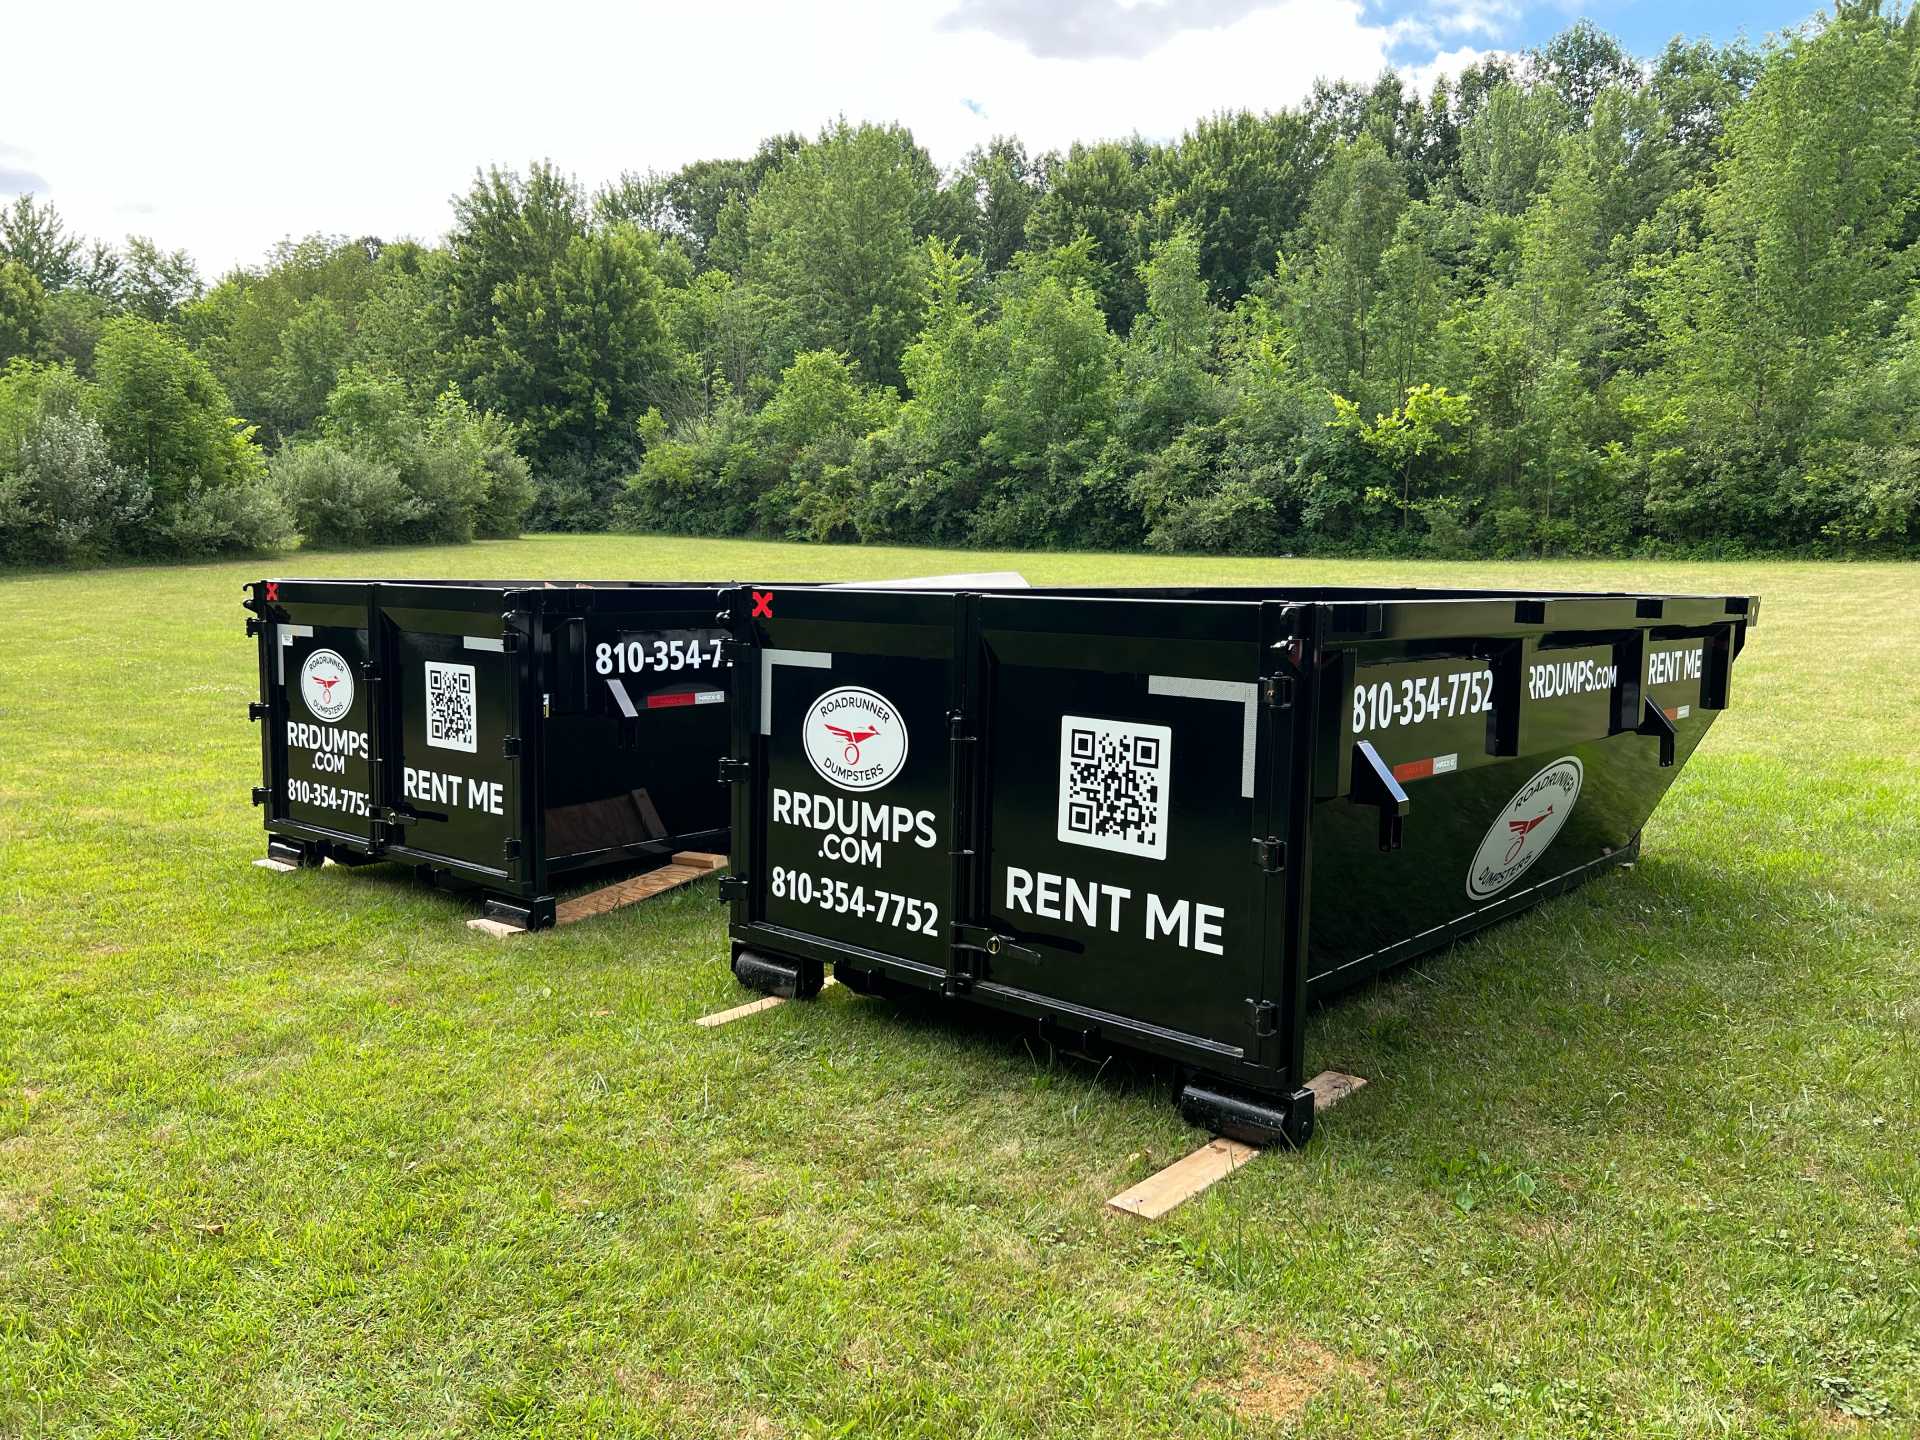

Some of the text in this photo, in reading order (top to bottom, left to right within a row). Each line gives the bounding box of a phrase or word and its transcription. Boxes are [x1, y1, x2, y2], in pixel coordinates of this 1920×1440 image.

[595, 639, 734, 675] 810-354-7
[1648, 648, 1703, 685] RENT ME
[1528, 659, 1618, 700] RRDUMPS.COM
[820, 696, 890, 724] ROADRUNNER
[1352, 669, 1494, 734] 810-354-7752
[287, 720, 369, 760] RRDUMPS
[312, 751, 345, 775] .COM
[823, 757, 884, 782] DUMPSTERS
[403, 766, 504, 816] RENT ME
[773, 788, 937, 849] RRDUMPS
[817, 833, 882, 869] .COM
[771, 865, 939, 938] 810-354-7752
[1005, 866, 1225, 956] RENT ME
